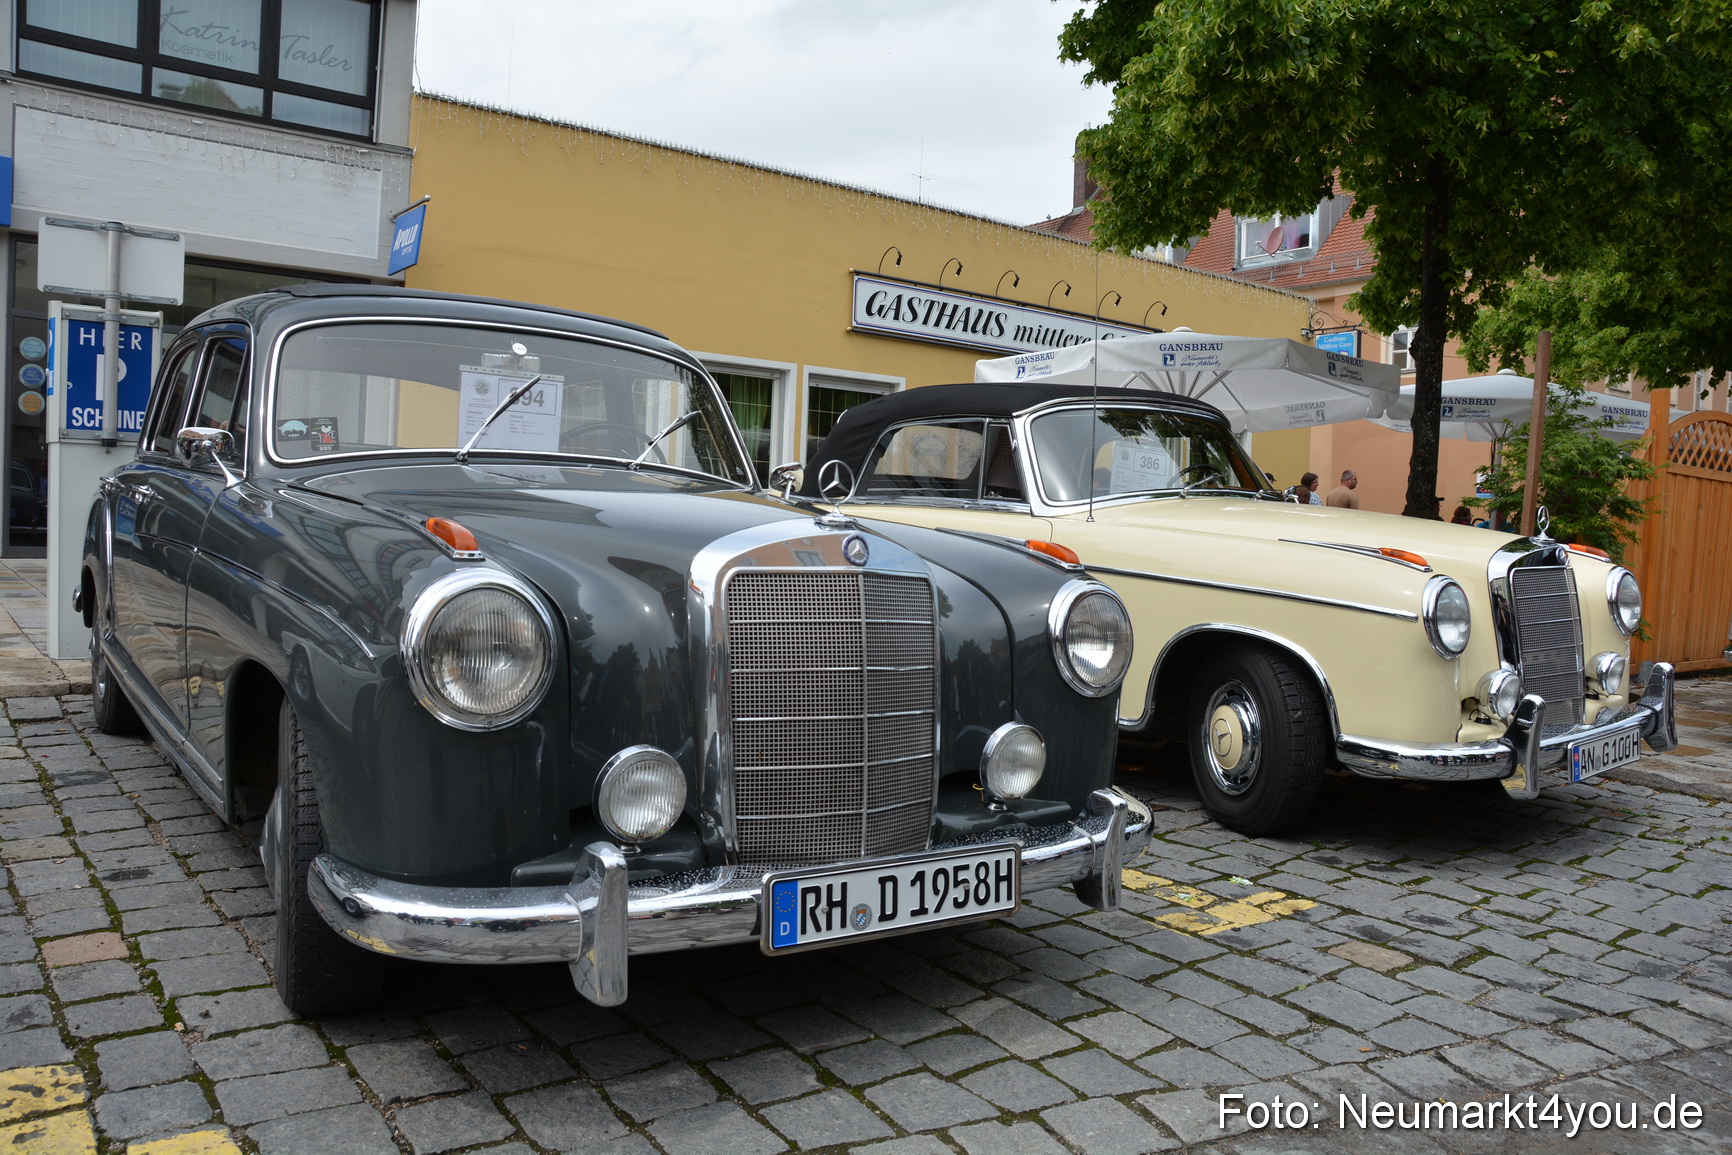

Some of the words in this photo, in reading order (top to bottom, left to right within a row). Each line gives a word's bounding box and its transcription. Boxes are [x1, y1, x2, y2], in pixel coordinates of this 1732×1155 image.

[160, 6, 260, 51] Katrin
[281, 35, 352, 71] Tasler
[161, 38, 234, 64] Kosmetik
[393, 223, 419, 252] APOLLO
[865, 289, 1008, 339] GASTHAUS
[1158, 343, 1224, 352] GANSBRÄU
[1318, 342, 1338, 350] Mittlere
[1015, 351, 1055, 365] GANSBRÄU
[1326, 351, 1364, 367] GANSBRÄU
[1440, 397, 1497, 406] GANSBRÄU
[1601, 405, 1648, 418] GANSBRÄU
[71, 406, 145, 430] SCHINE
[1140, 456, 1160, 470] 386
[1580, 745, 1595, 775] AN
[1602, 741, 1609, 767] G
[1611, 732, 1639, 764] 100H
[780, 922, 790, 936] D
[800, 881, 848, 935] RH
[878, 875, 898, 923] D
[910, 858, 1013, 917] 1958H
